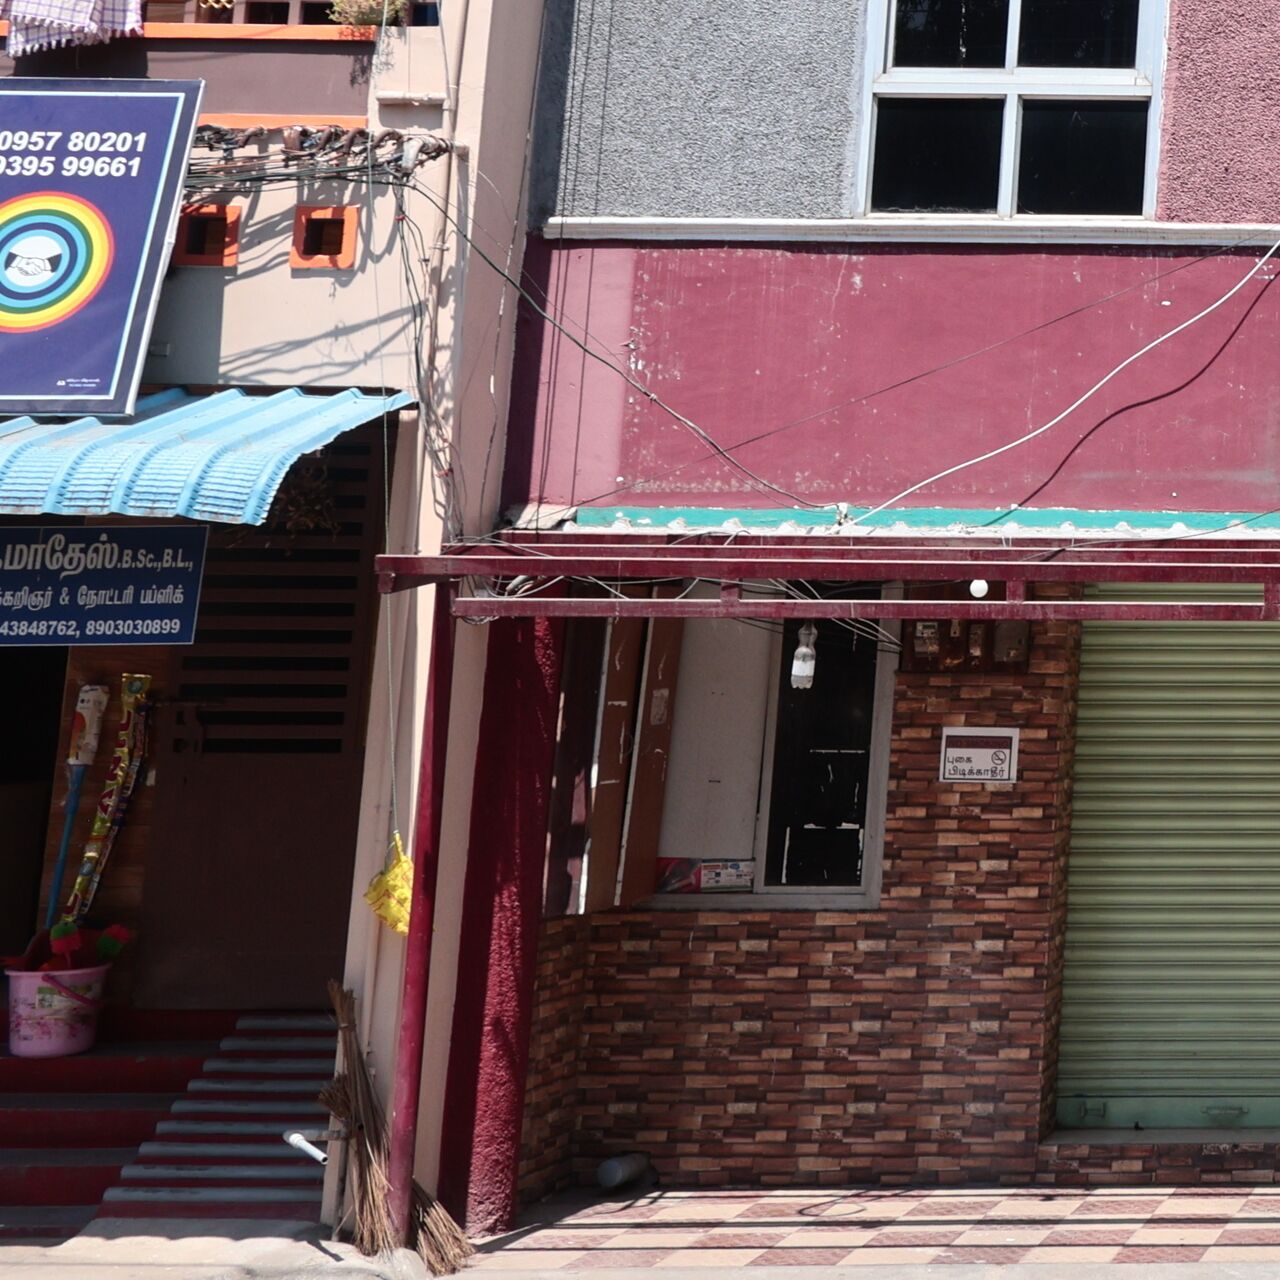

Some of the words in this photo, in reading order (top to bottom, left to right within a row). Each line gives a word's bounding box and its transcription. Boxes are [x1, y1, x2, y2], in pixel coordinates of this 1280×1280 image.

[68, 132, 147, 152] 80201
[61, 157, 141, 177] 99661
[59, 587, 70, 605] &
[85, 619, 181, 636] 8903030899
